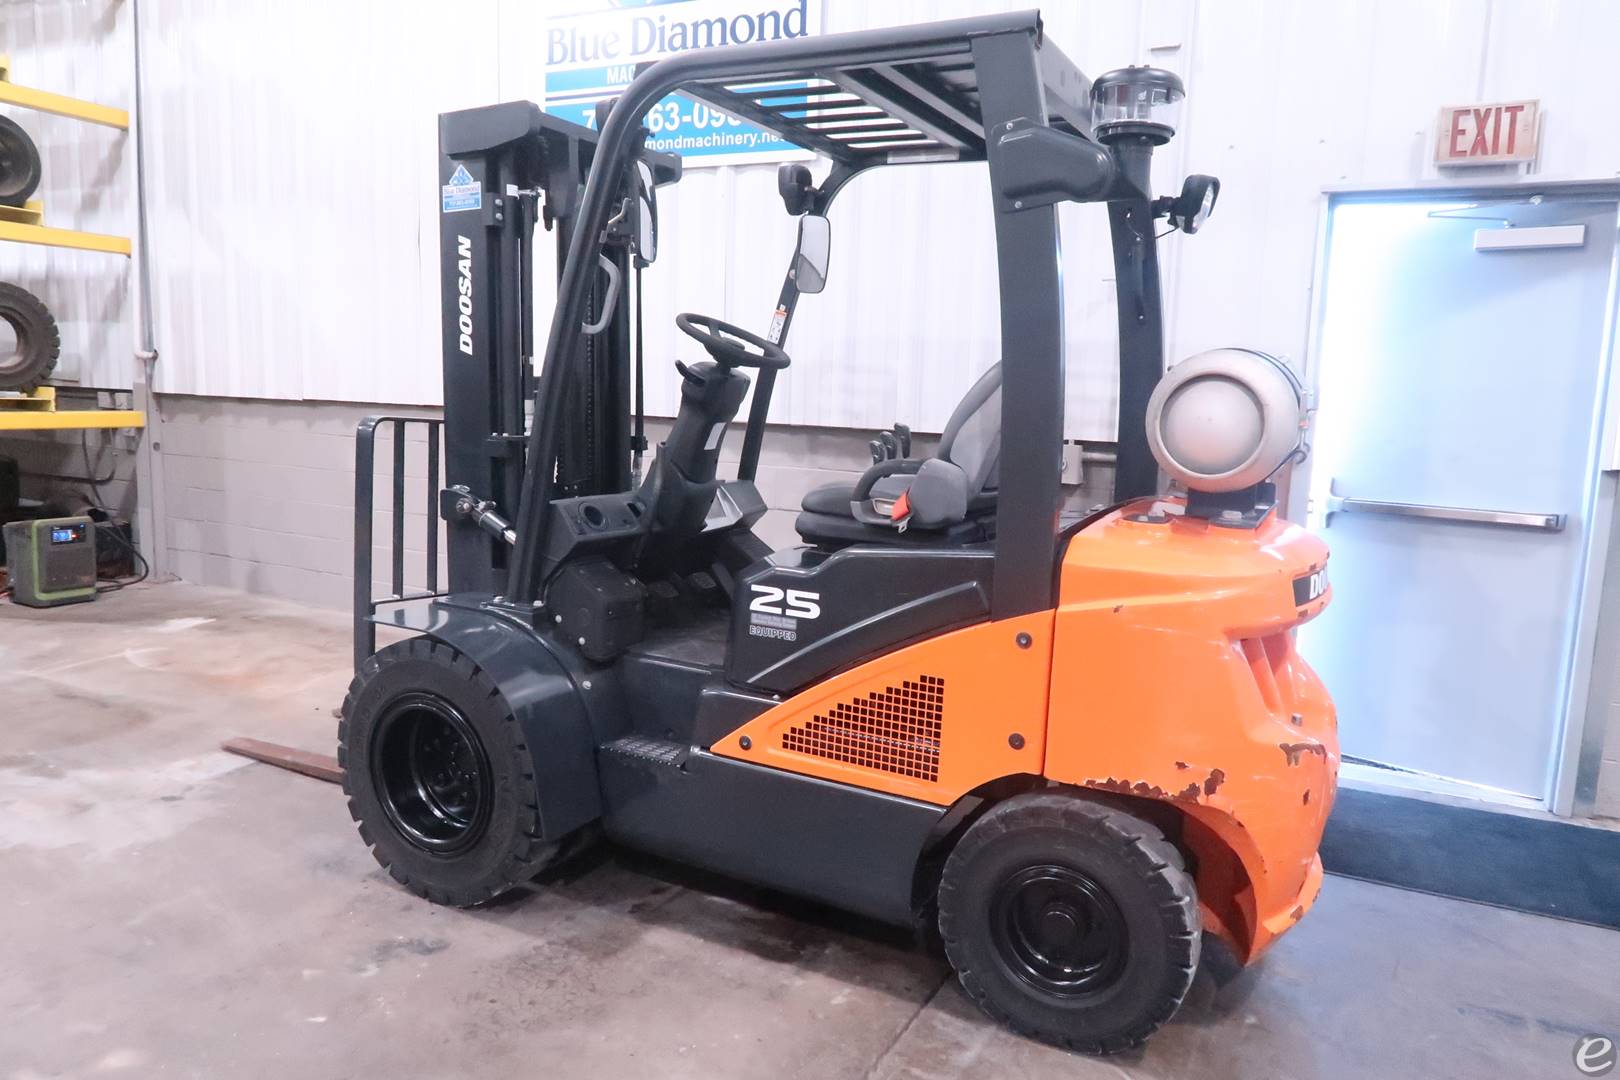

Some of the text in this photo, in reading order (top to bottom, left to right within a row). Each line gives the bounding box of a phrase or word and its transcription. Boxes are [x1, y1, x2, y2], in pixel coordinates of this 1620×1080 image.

[545, 0, 808, 66] Blue Diamond
[644, 131, 786, 151] mondmachinery.ne
[1449, 105, 1524, 157] EXIT
[458, 234, 473, 355] DOOSAN
[749, 584, 821, 619] 25
[749, 625, 797, 641] EQUIPPED
